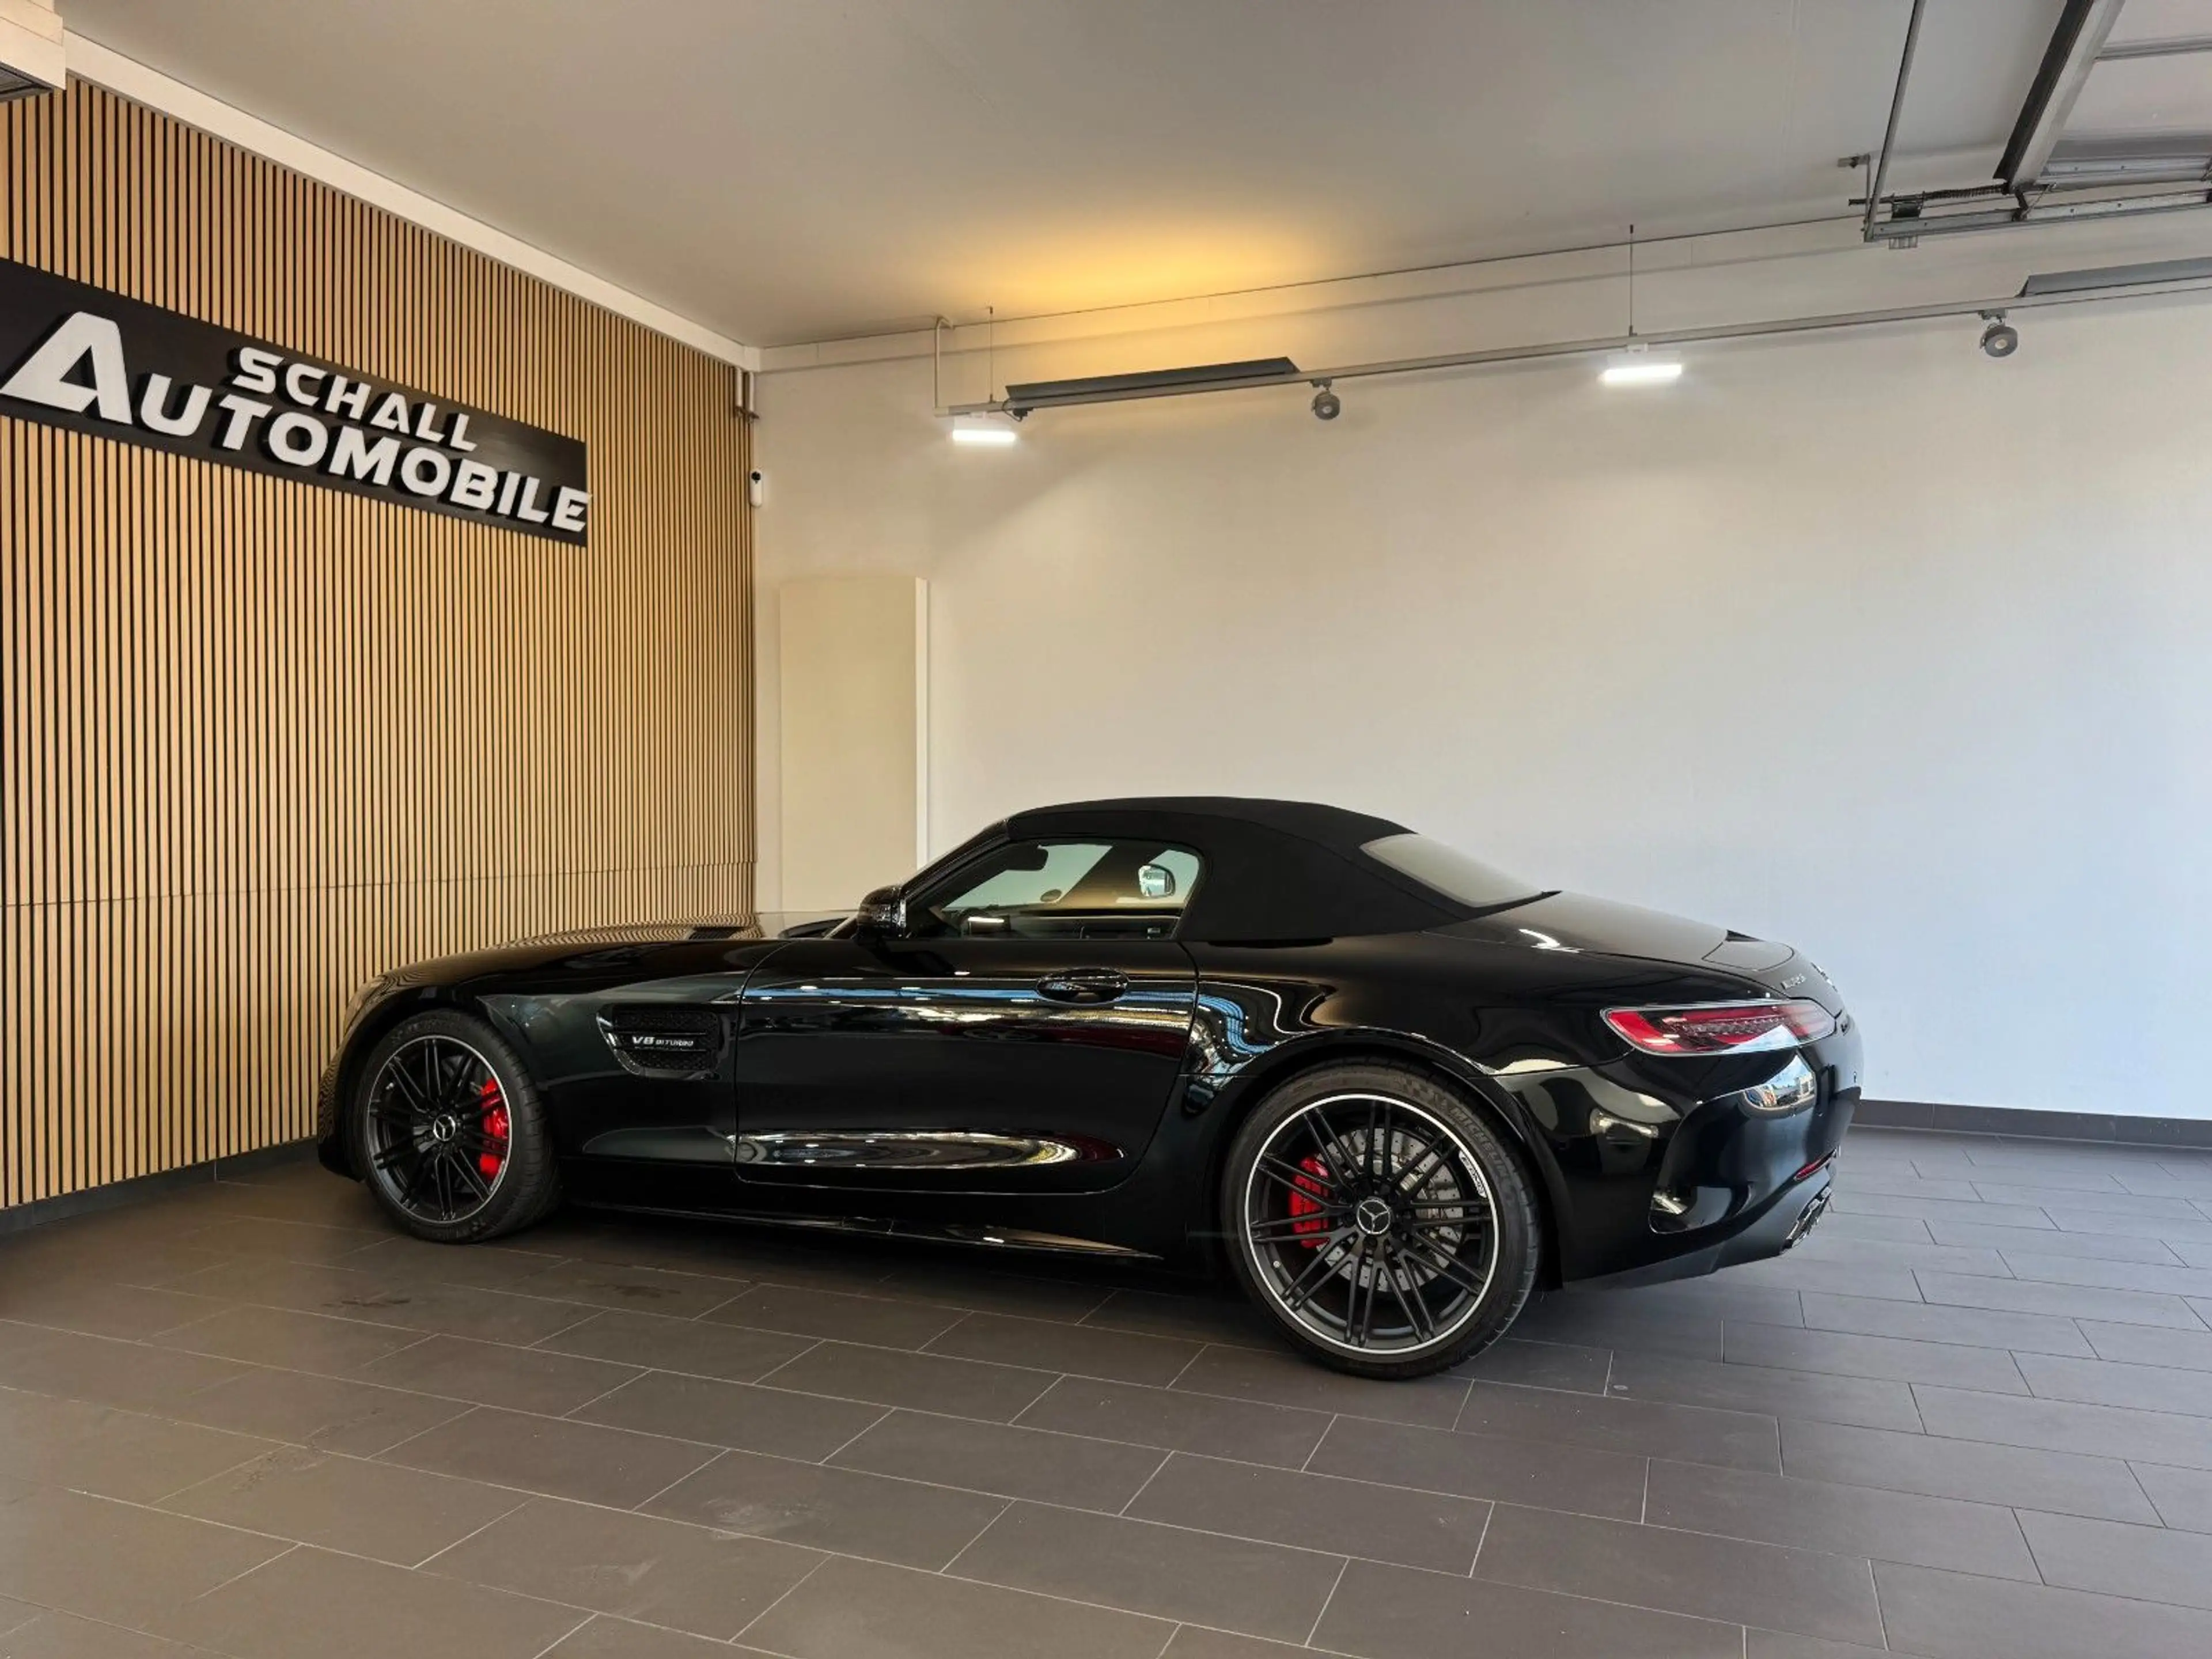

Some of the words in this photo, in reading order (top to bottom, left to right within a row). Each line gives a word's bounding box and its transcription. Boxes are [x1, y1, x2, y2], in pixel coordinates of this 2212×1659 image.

[0, 310, 590, 532] AUTOMOBILE
[232, 347, 478, 452] SCHALL
[632, 1036, 655, 1044] V8
